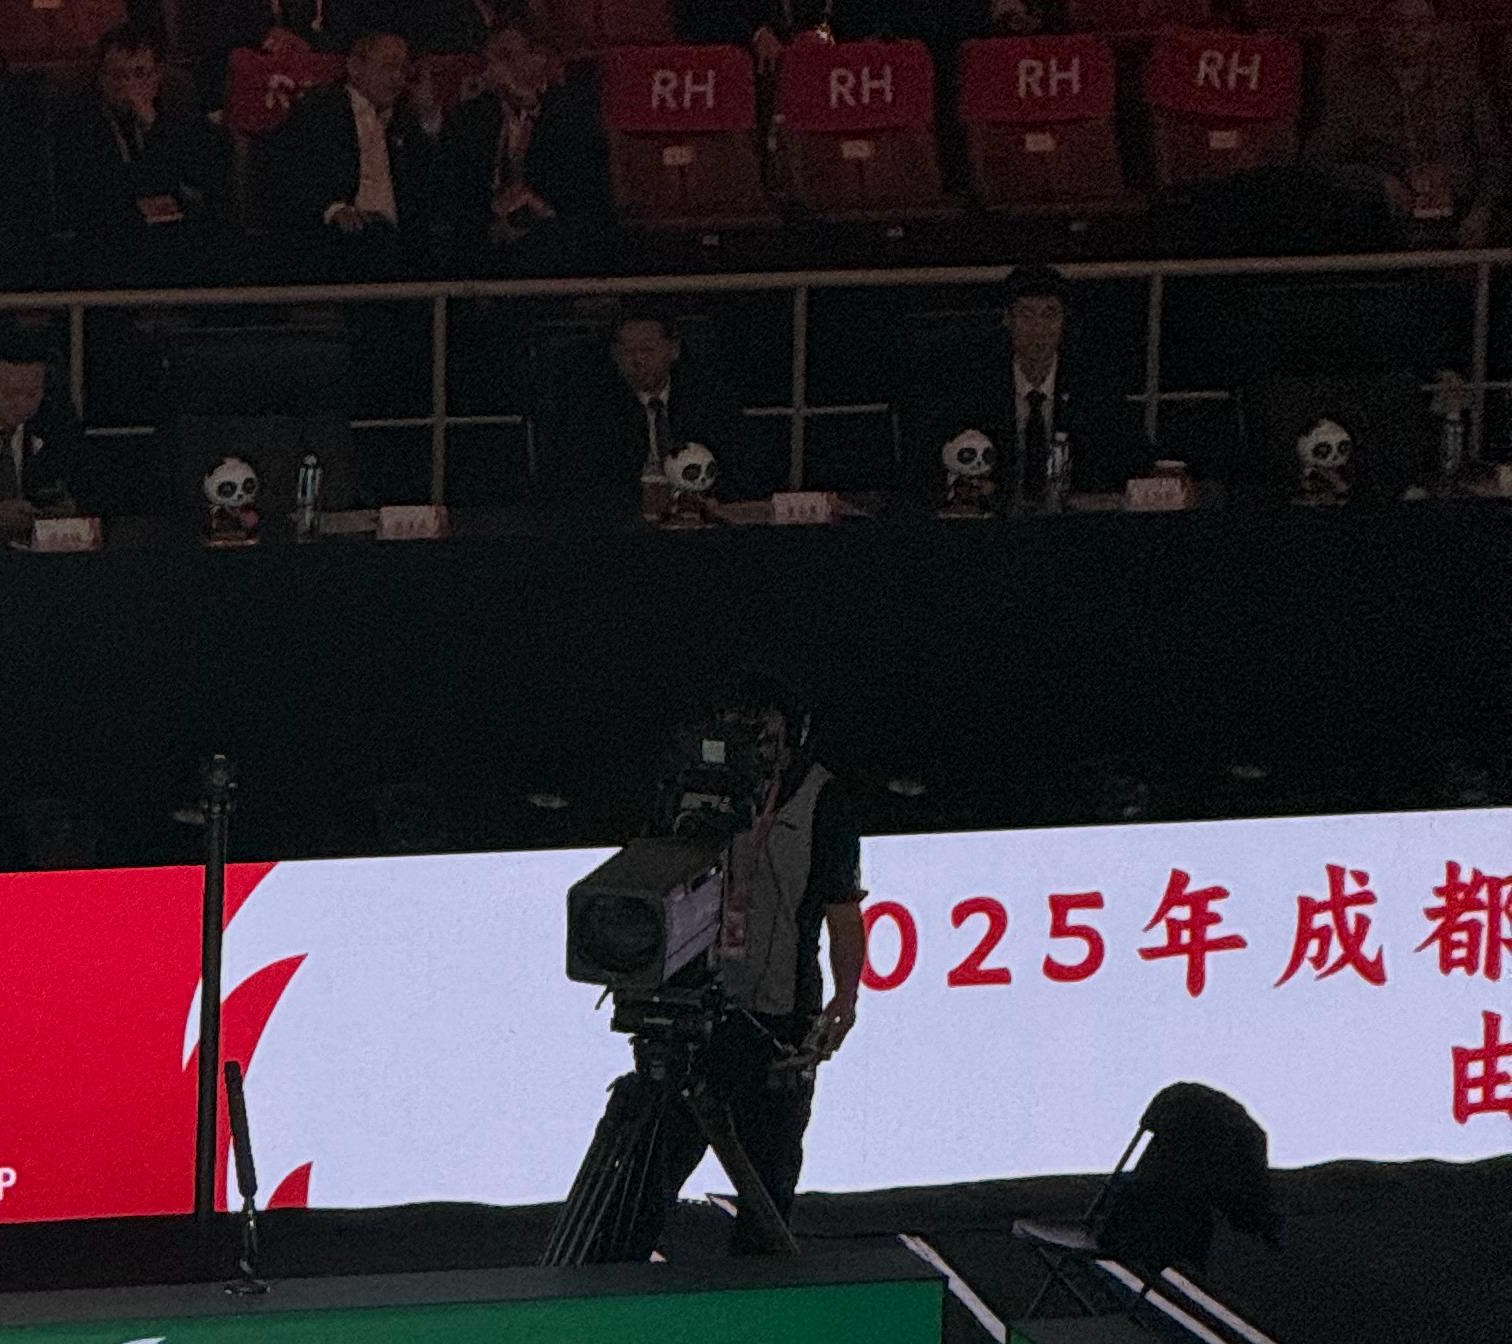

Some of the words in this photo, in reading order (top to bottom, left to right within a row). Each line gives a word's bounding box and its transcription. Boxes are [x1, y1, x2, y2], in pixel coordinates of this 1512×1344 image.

[651, 68, 716, 109] RH
[829, 63, 893, 109] RH
[1016, 56, 1081, 99] RH
[1197, 49, 1262, 92] RH
